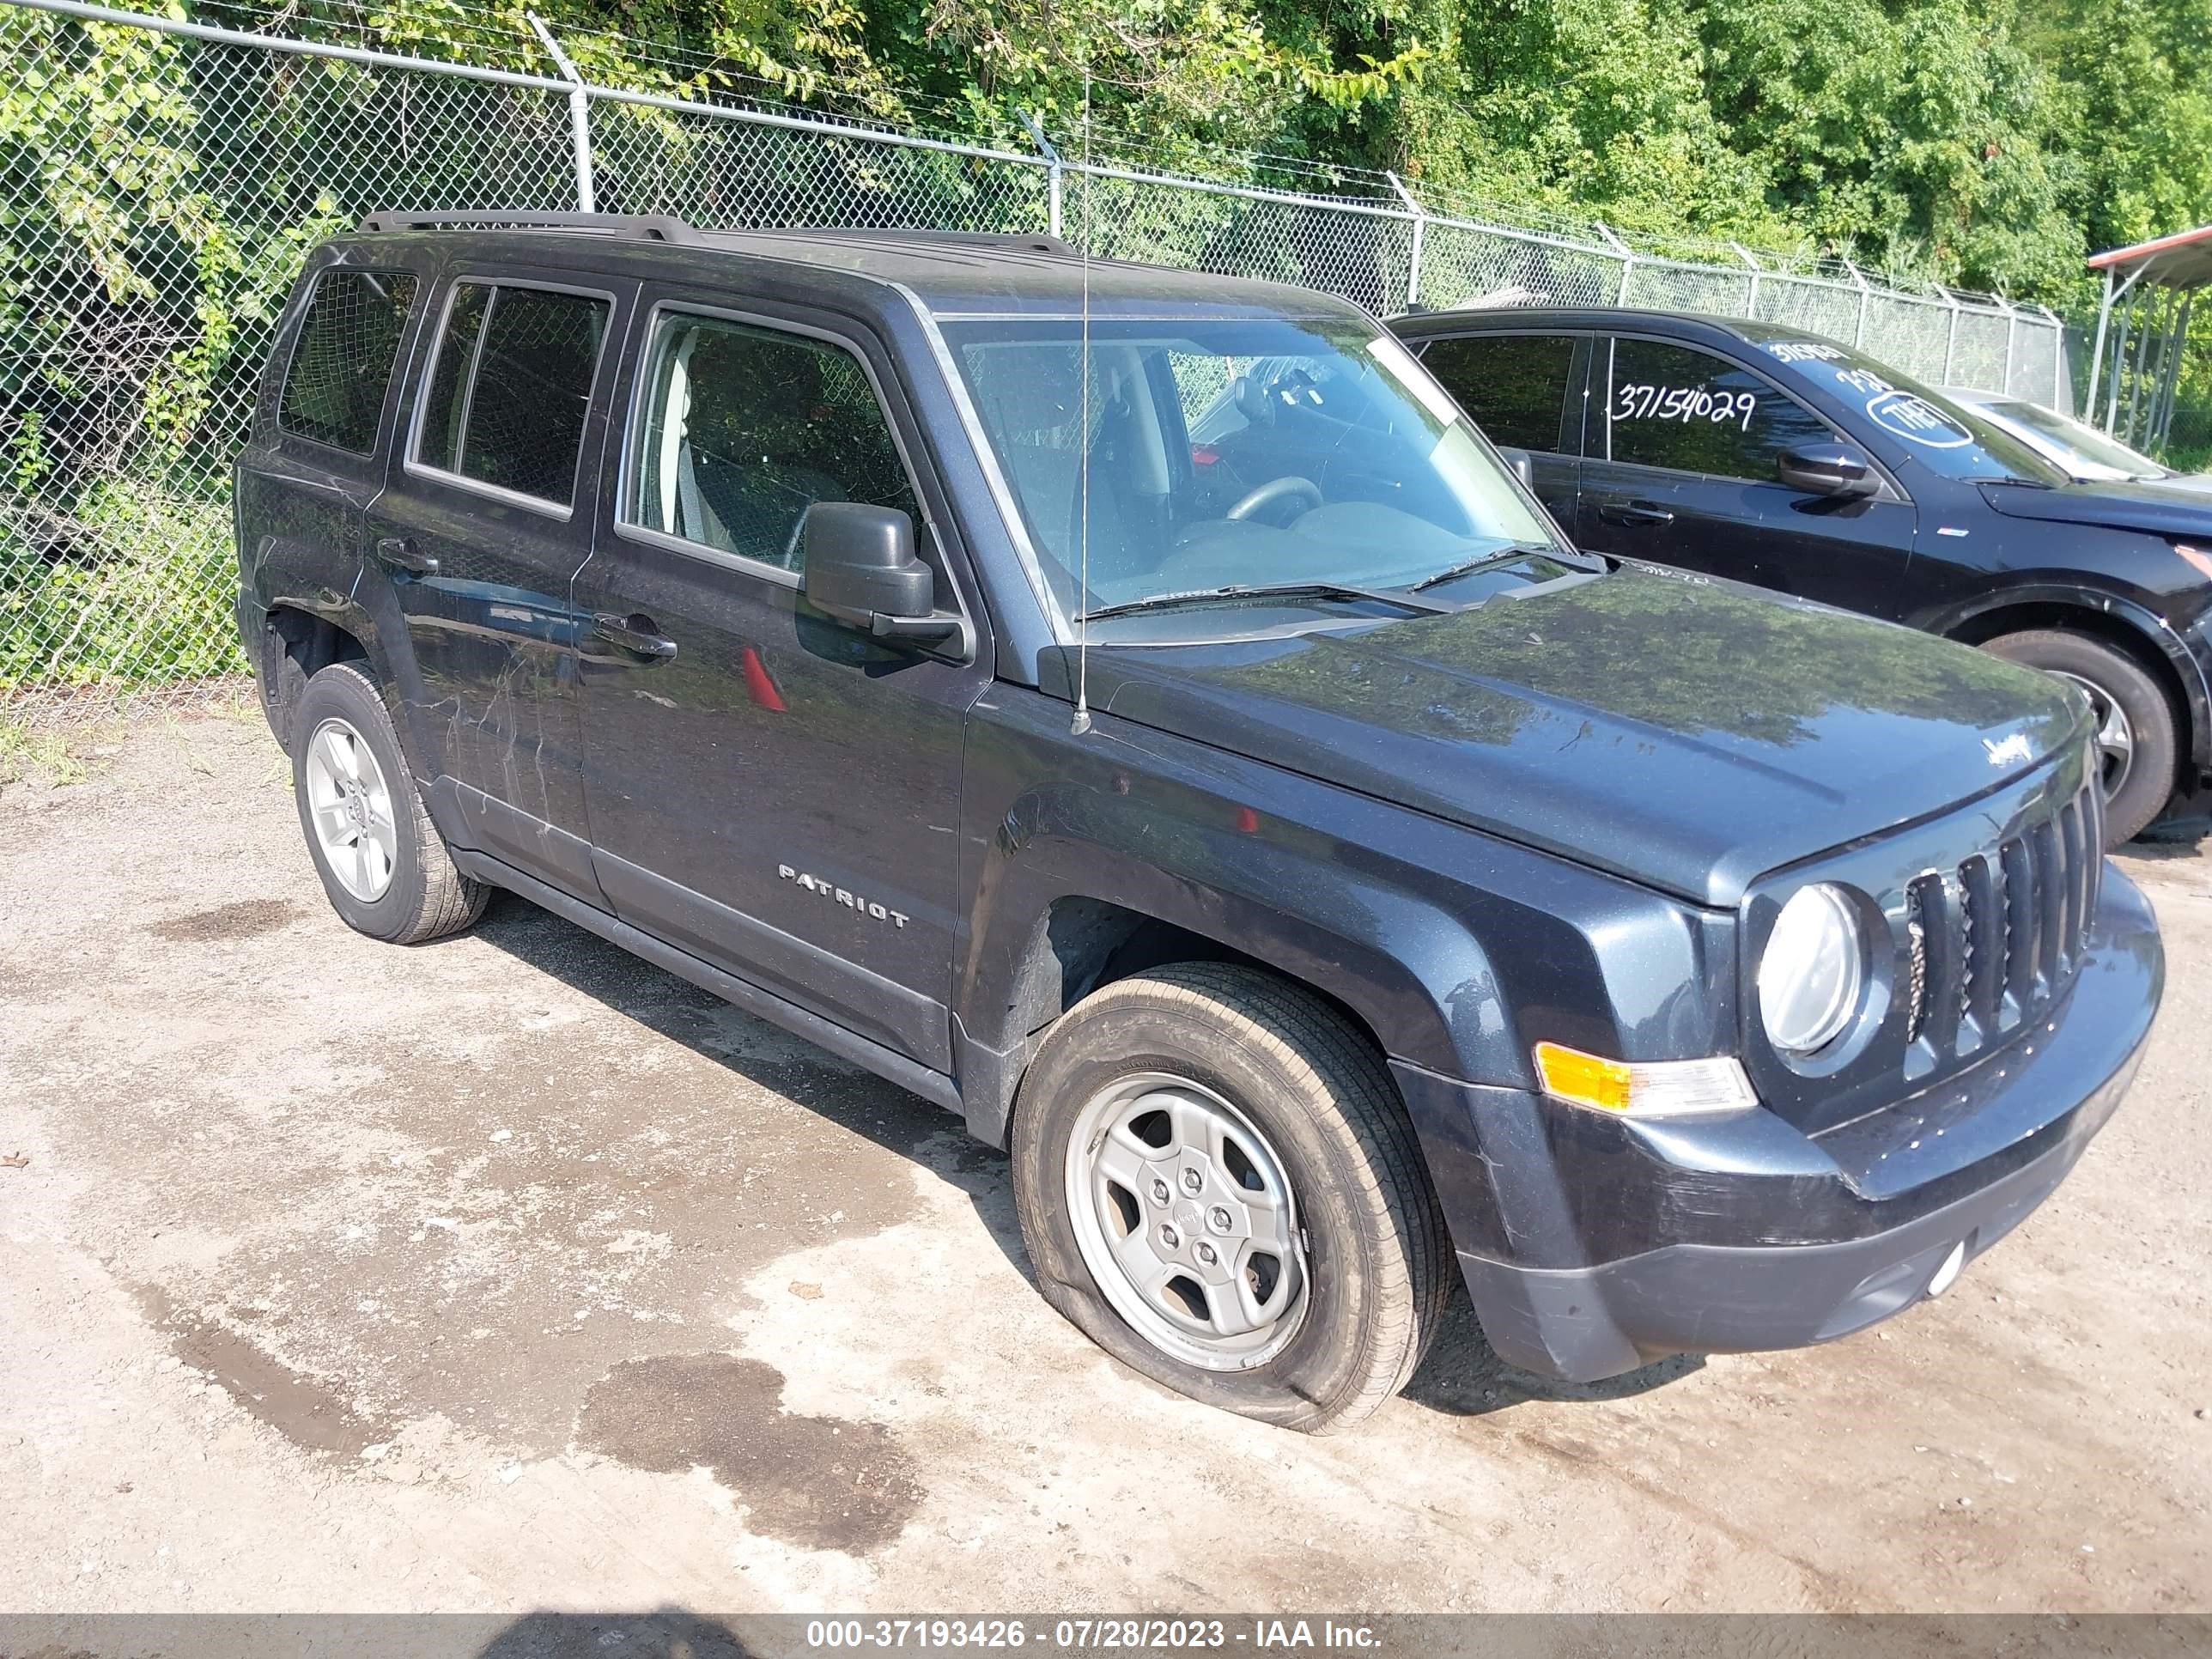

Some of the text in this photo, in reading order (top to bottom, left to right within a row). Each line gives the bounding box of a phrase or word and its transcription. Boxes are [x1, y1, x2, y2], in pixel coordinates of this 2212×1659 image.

[1612, 383, 1755, 432] 37154029
[1881, 398, 1952, 430] THEFT
[778, 864, 909, 928] PATRIOT
